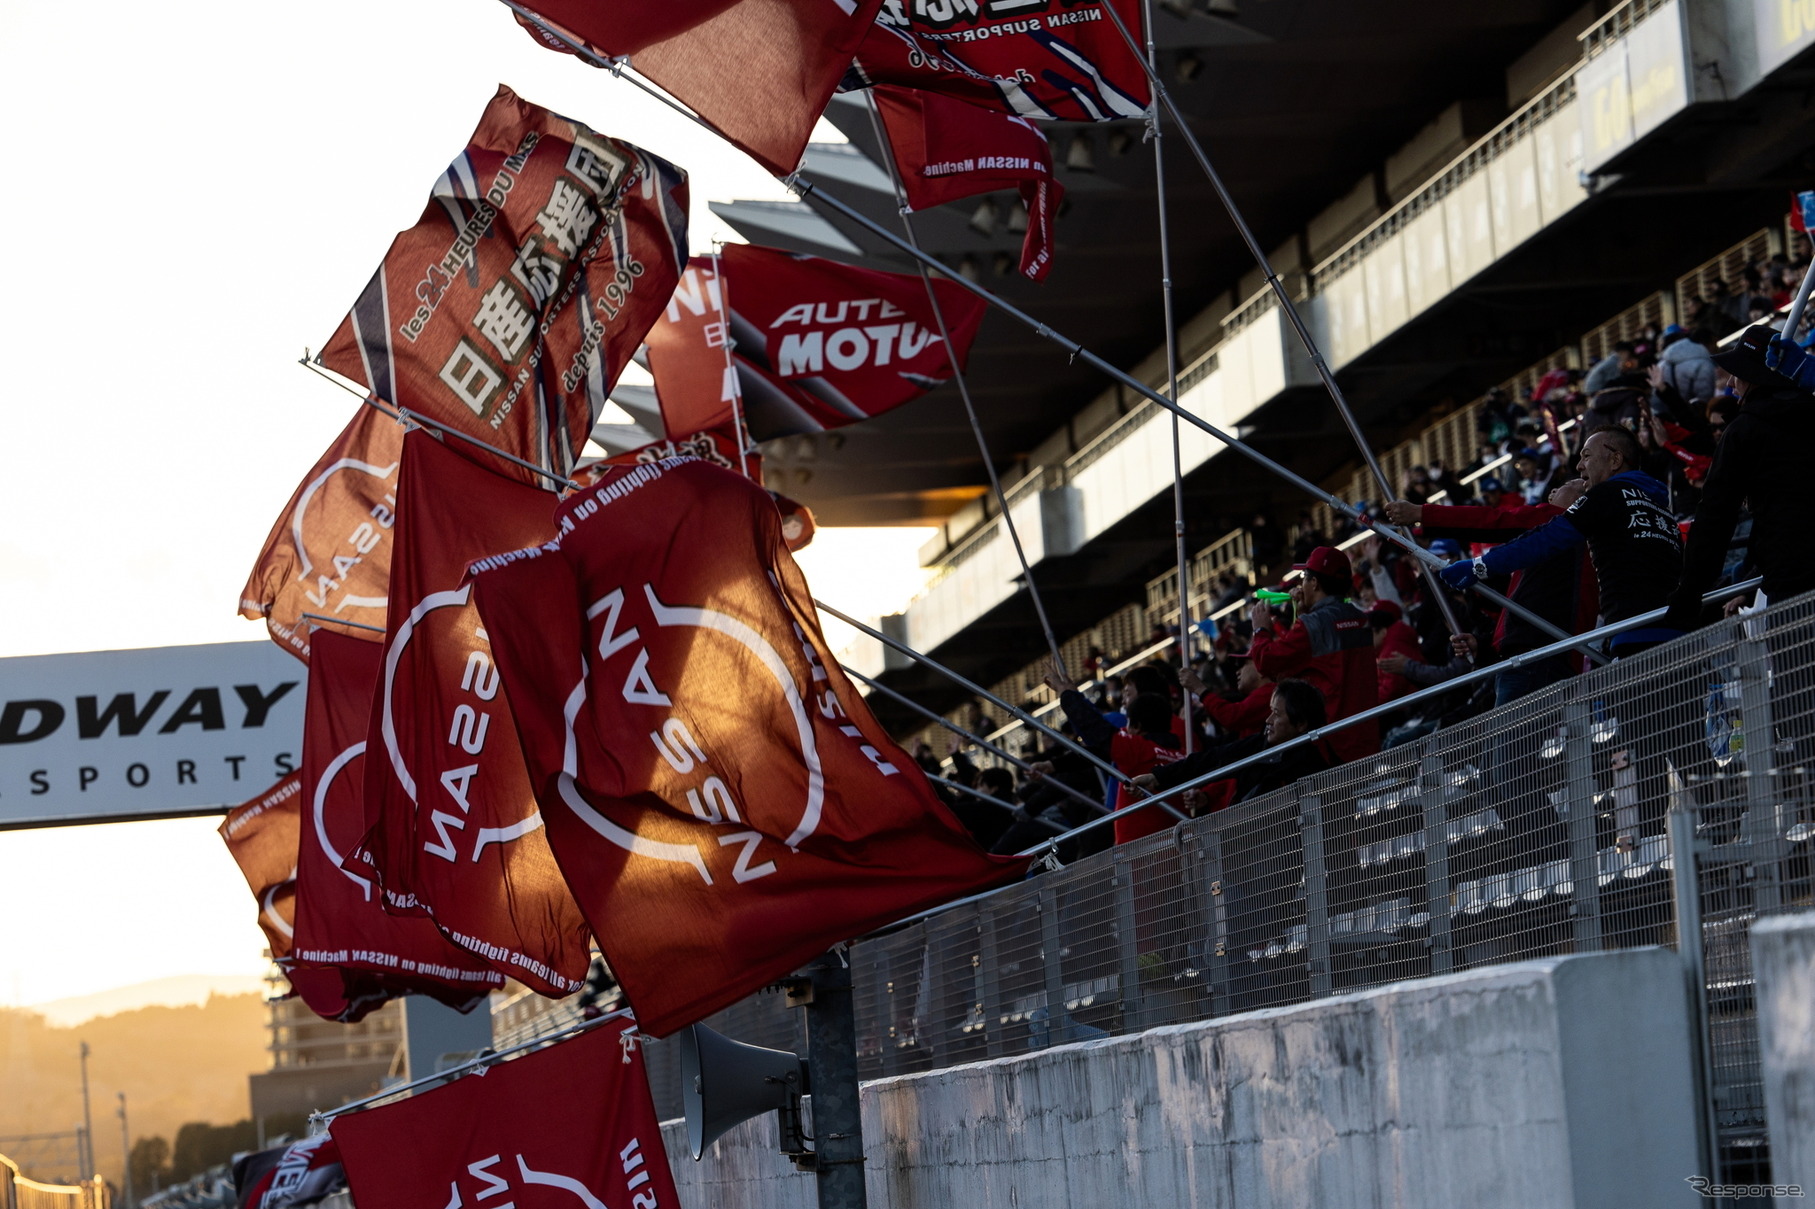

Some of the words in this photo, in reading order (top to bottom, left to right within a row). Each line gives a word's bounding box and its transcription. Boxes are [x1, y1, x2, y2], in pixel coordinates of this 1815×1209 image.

[400, 309, 432, 343] les
[416, 264, 449, 310] 24
[441, 202, 497, 281] HEURES
[486, 169, 515, 209] DU
[563, 318, 606, 393] depuis
[595, 255, 645, 320] 1996
[778, 321, 945, 378] MOTU
[489, 368, 530, 430] NISSAN
[573, 499, 598, 521] on
[596, 463, 663, 506] fighting
[1641, 530, 1652, 538] 24
[586, 586, 778, 885] NSSAN
[30, 753, 294, 795] SPORTS
